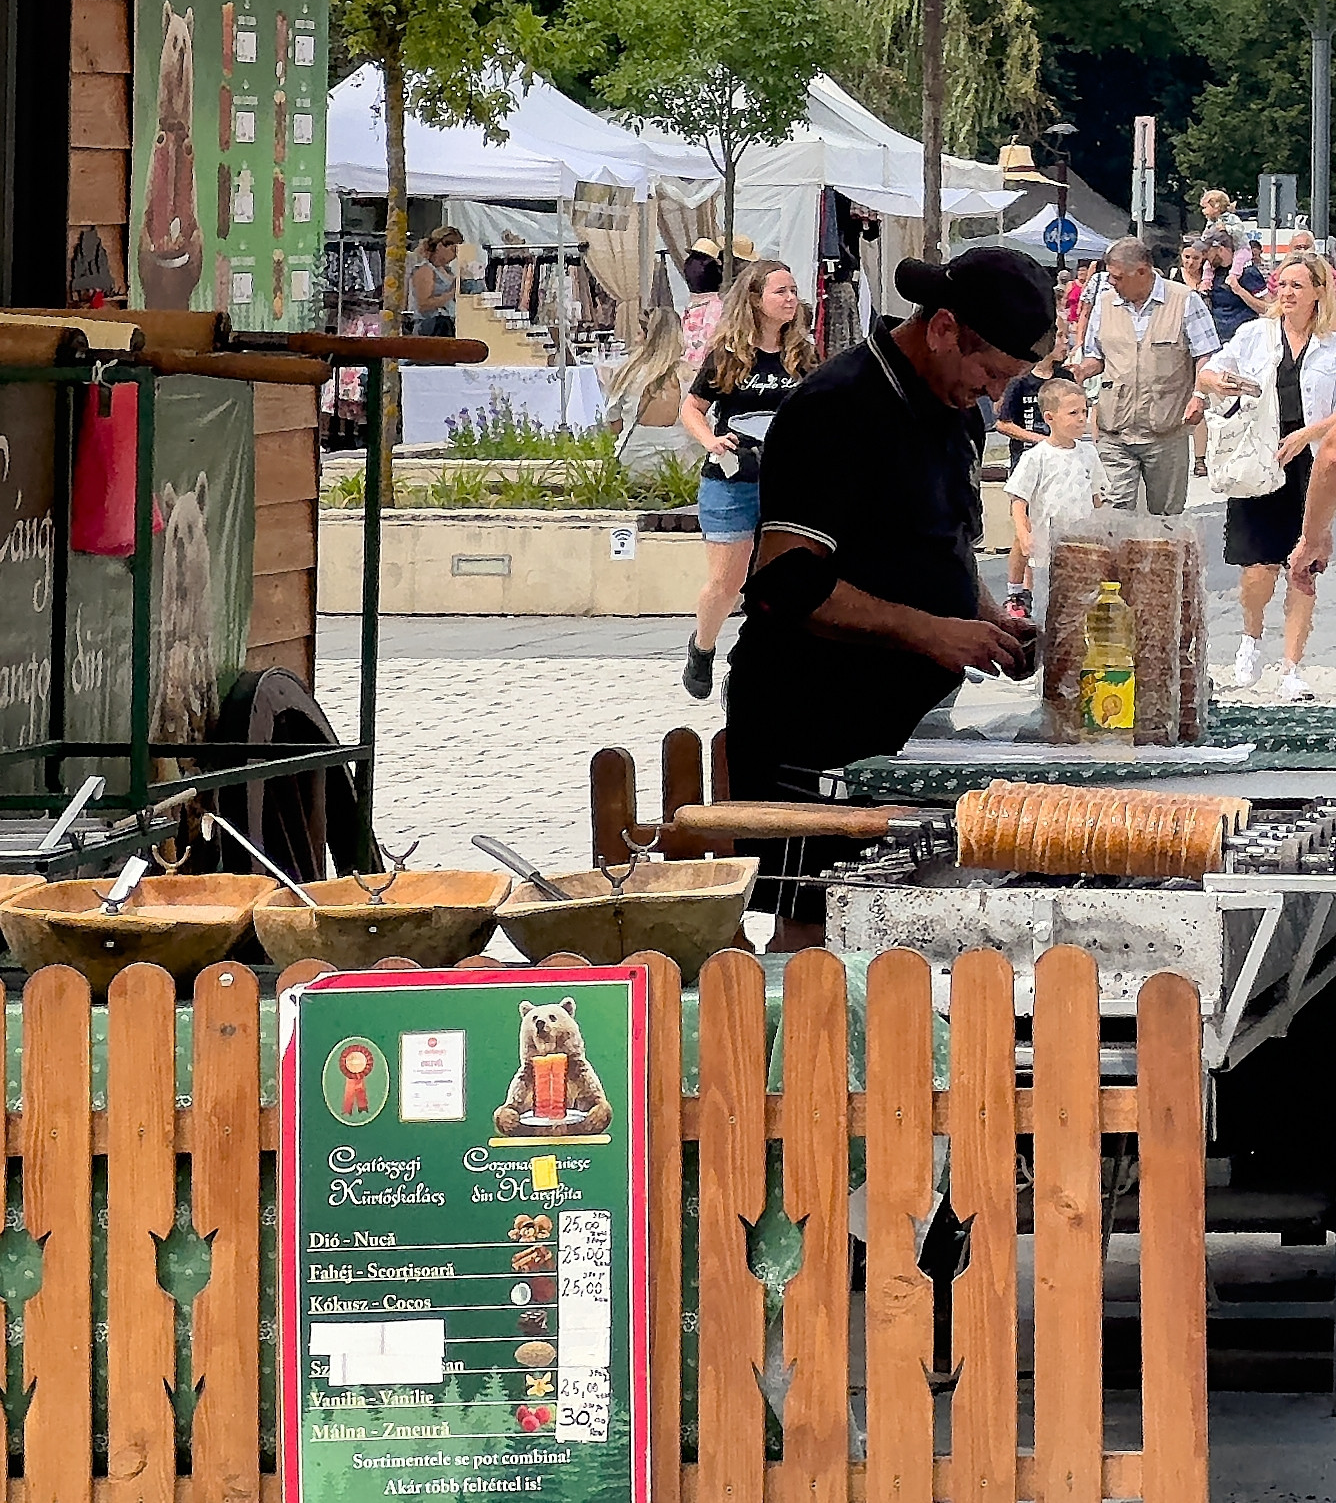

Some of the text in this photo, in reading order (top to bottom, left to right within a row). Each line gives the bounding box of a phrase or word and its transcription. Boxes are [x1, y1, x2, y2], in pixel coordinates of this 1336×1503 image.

[328, 1145, 421, 1182] Csatószegi
[328, 1178, 446, 1208] Kürtőskalács
[471, 1184, 493, 1203] din
[309, 1232, 340, 1248] Dió
[354, 1230, 396, 1247] Nucă
[562, 1244, 604, 1264] 25,00
[309, 1264, 353, 1284] Fahéj
[562, 1277, 602, 1297] 25,00
[309, 1296, 369, 1313] Kókusz
[383, 1294, 432, 1311] Cocos
[380, 1388, 434, 1405] Vanilie
[311, 1423, 367, 1440] Málna
[383, 1422, 450, 1438] Zmeură
[352, 1448, 572, 1470] Sortimentele se pot combina!
[383, 1475, 542, 1496] Akár több feltéttel is!
